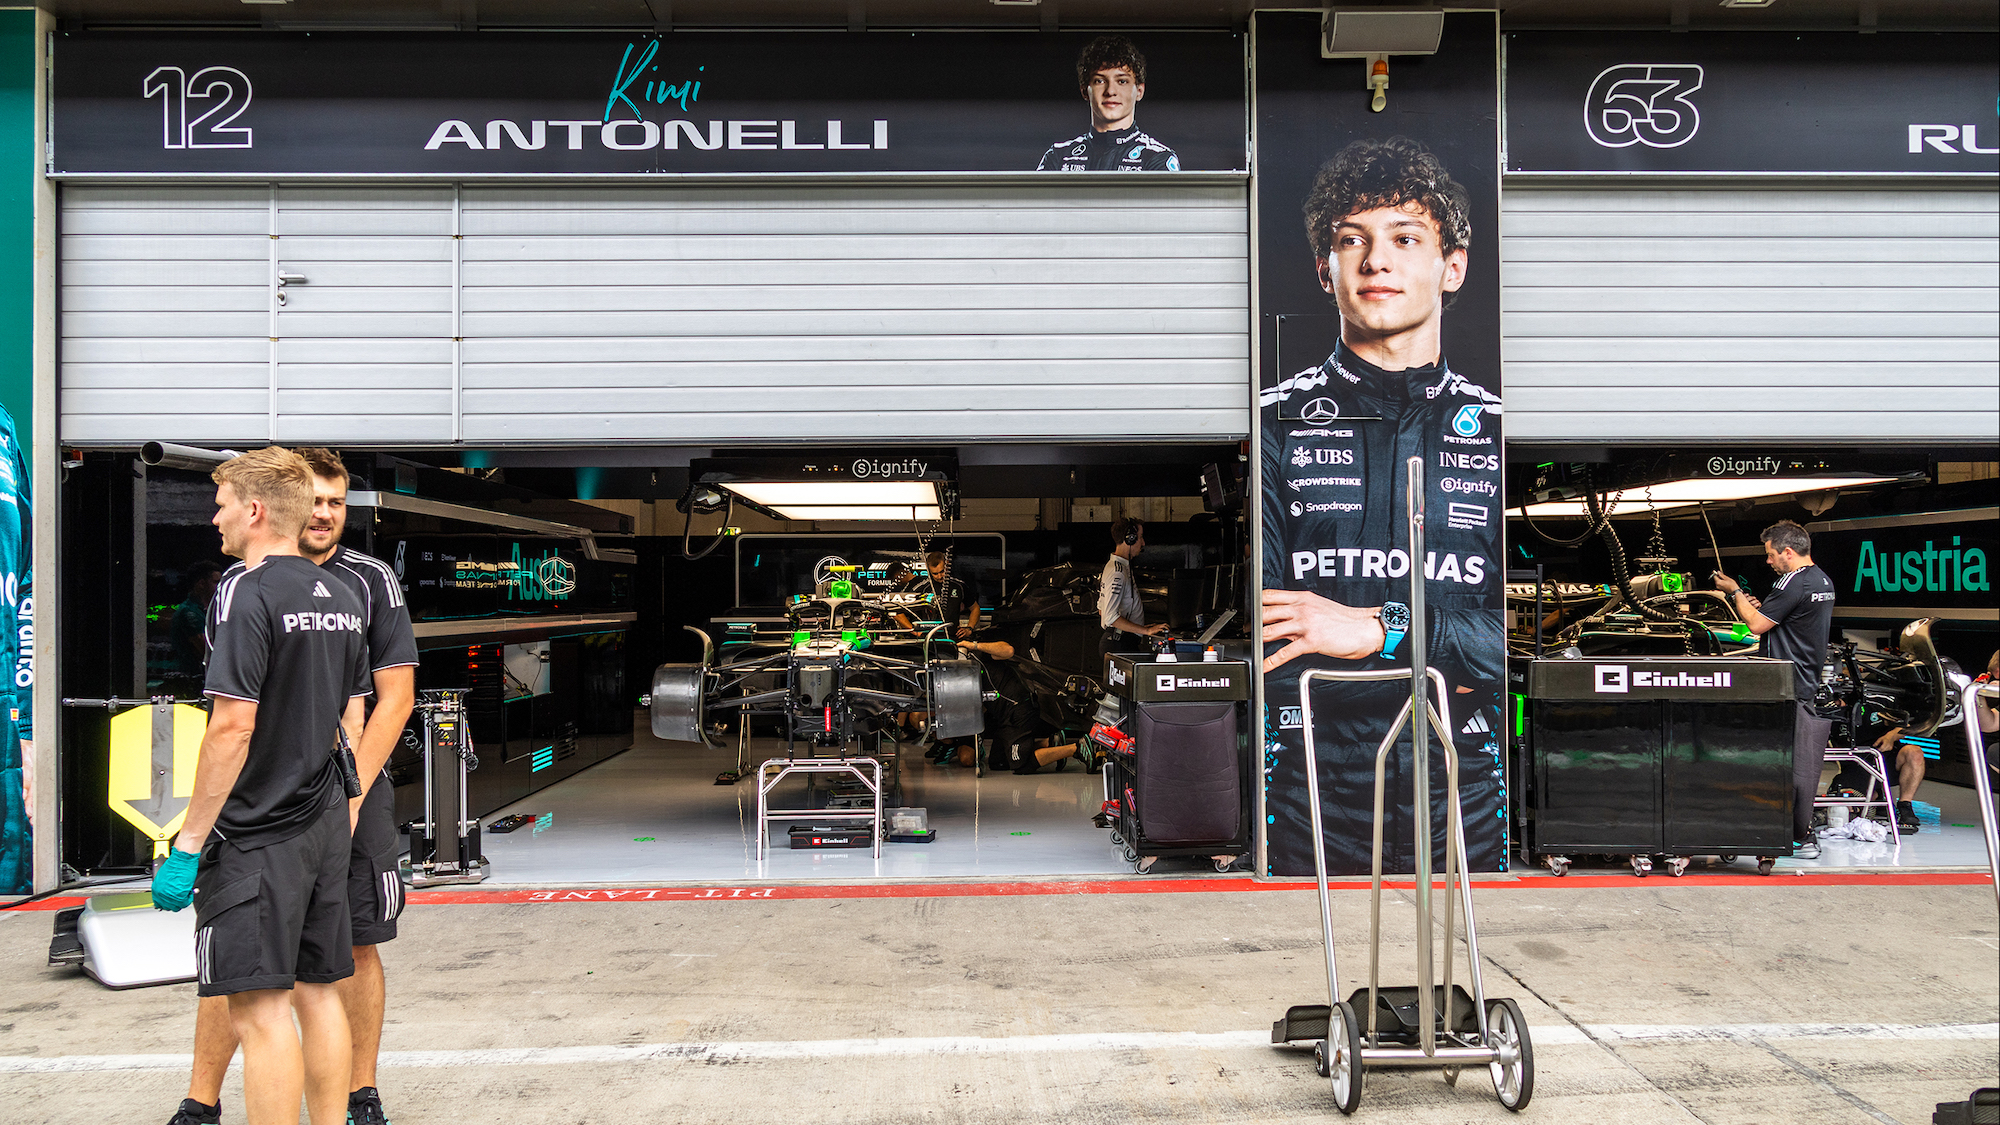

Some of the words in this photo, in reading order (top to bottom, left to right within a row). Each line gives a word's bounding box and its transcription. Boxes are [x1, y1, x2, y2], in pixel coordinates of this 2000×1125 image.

[603, 39, 705, 122] Kimi
[143, 66, 253, 149] 12
[1584, 64, 1704, 148] 63
[424, 119, 888, 150] ANTONELLI
[1443, 435, 1492, 445] PETRONAS
[1315, 448, 1354, 465] UBS
[1439, 452, 1499, 471] INEOS
[1292, 477, 1362, 487] CROWDSTRIKE
[1306, 501, 1362, 513] Snapdragon
[1854, 535, 1990, 593] Austria
[282, 611, 362, 634] PETRONAS
[1177, 678, 1230, 687] Einhell
[1633, 671, 1732, 688] Einhell
[529, 888, 777, 900] PIT-LANE
